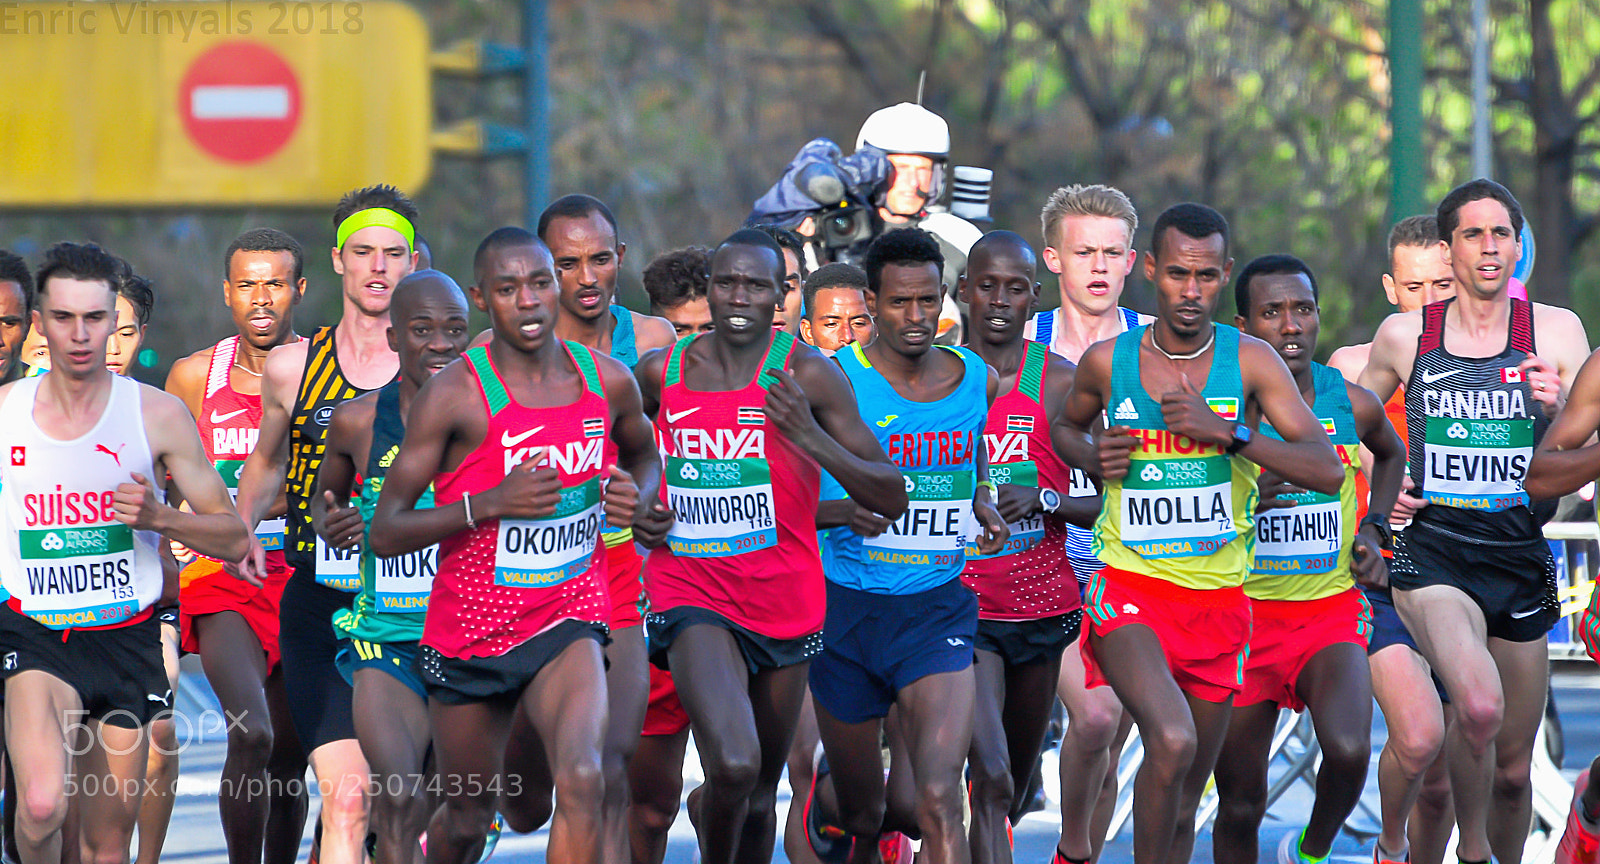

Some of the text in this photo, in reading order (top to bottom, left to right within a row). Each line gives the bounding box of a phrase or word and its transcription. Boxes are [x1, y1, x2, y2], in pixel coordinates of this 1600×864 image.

[1423, 389, 1527, 420] CANADA
[1470, 422, 1510, 432] TRINIDAD
[1470, 431, 1510, 440] ALFONSO
[669, 428, 766, 460] KENYA
[888, 430, 974, 467] ERITREA
[1165, 462, 1207, 471] TRINIDAD
[1431, 452, 1527, 482] LEVINS
[918, 475, 953, 484] TRINIDAD
[917, 484, 953, 493] ALFONSO
[24, 484, 115, 527] suisse
[671, 492, 770, 525] KAMWOROR
[1128, 492, 1228, 526] MOLLA
[1430, 496, 1523, 509] VALENCIA 2018
[750, 517, 773, 529] 116
[1019, 519, 1041, 531] 117
[1218, 518, 1232, 531] 72
[1257, 510, 1338, 543] GETAHUN
[505, 513, 598, 555] OKOMBO
[669, 535, 767, 553] VALENCIA 2018
[1006, 536, 1035, 550] 2018
[1127, 538, 1228, 555] VALENCIA 2018
[1328, 539, 1339, 550] 71
[382, 548, 440, 578] MOK
[868, 550, 930, 564] VALENCIA
[1305, 557, 1334, 569] 2018
[27, 559, 131, 595] WANDERS
[503, 569, 565, 584] VALENCIA
[112, 586, 135, 600] 153
[30, 605, 132, 626] VALENCIA 2018
